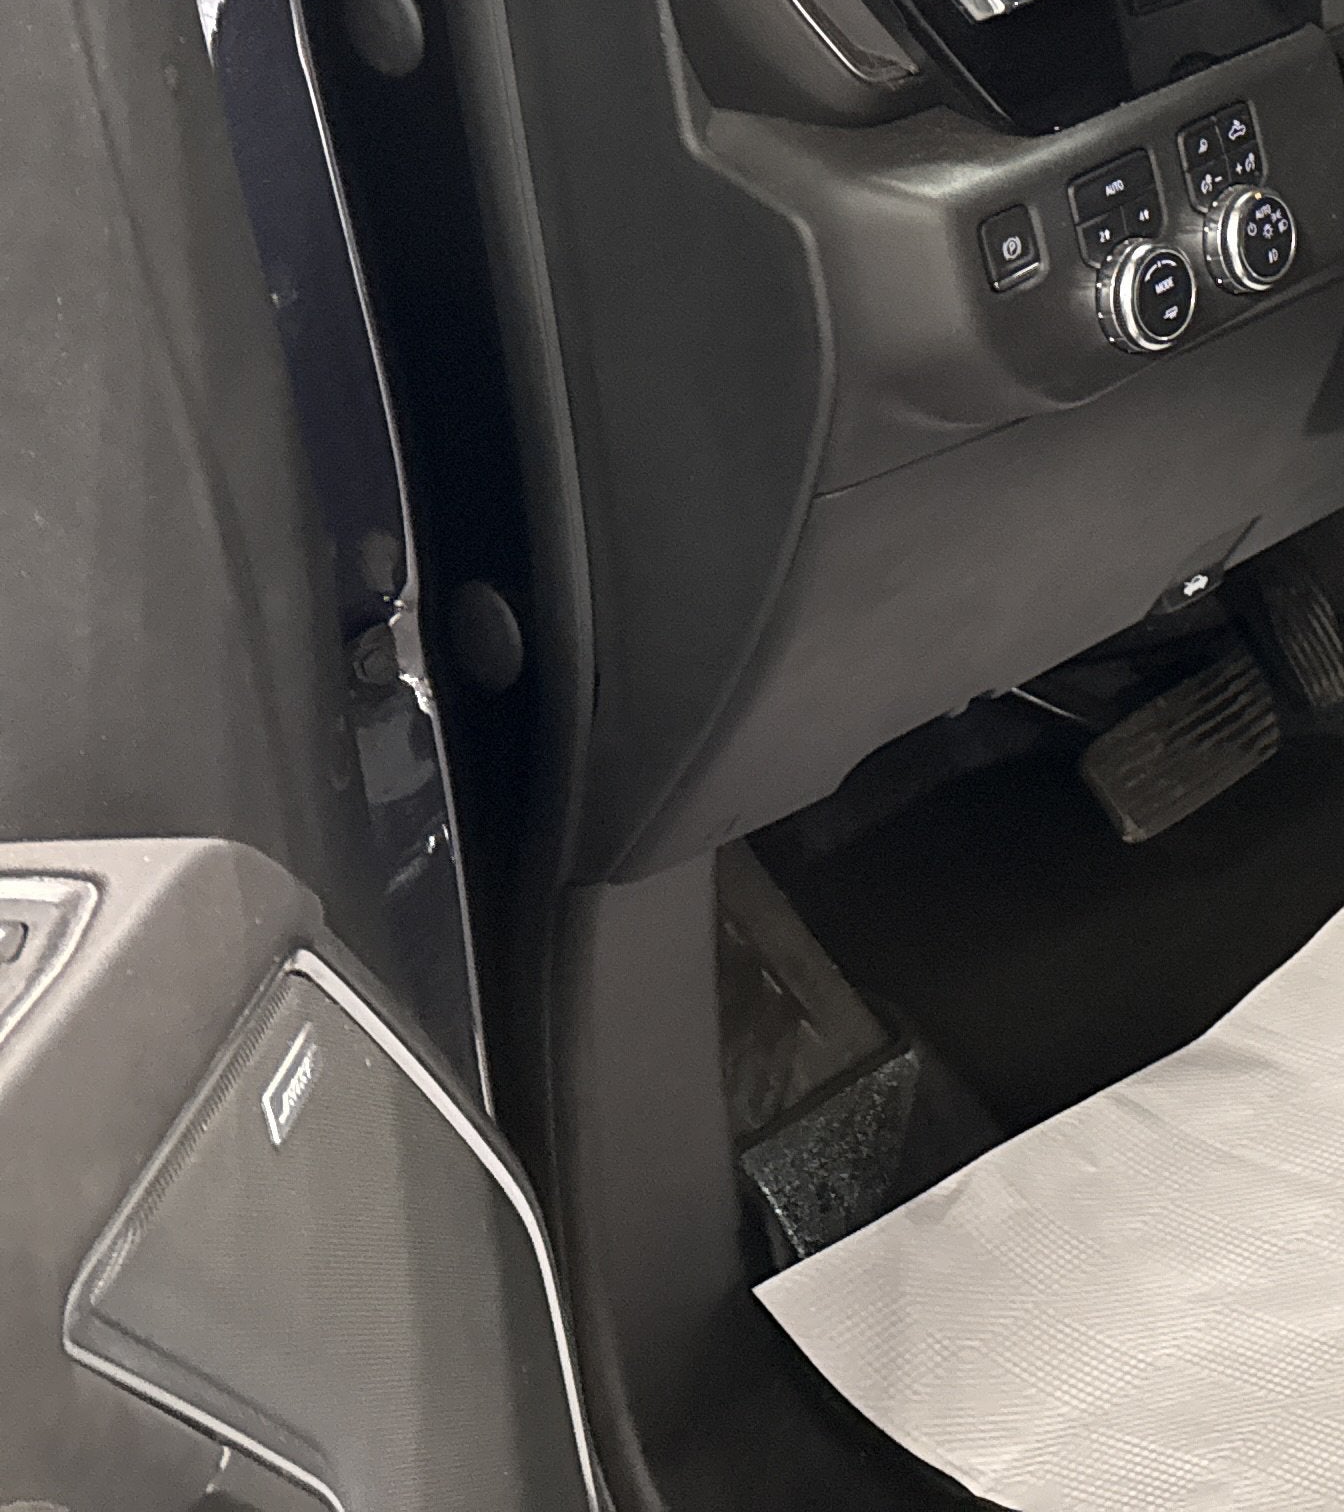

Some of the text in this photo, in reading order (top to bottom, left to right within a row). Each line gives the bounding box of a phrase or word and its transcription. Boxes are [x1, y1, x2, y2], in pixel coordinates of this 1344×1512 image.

[1105, 179, 1125, 197] AUTO
[1255, 203, 1272, 220] AUTO
[1154, 276, 1175, 295] MODE
